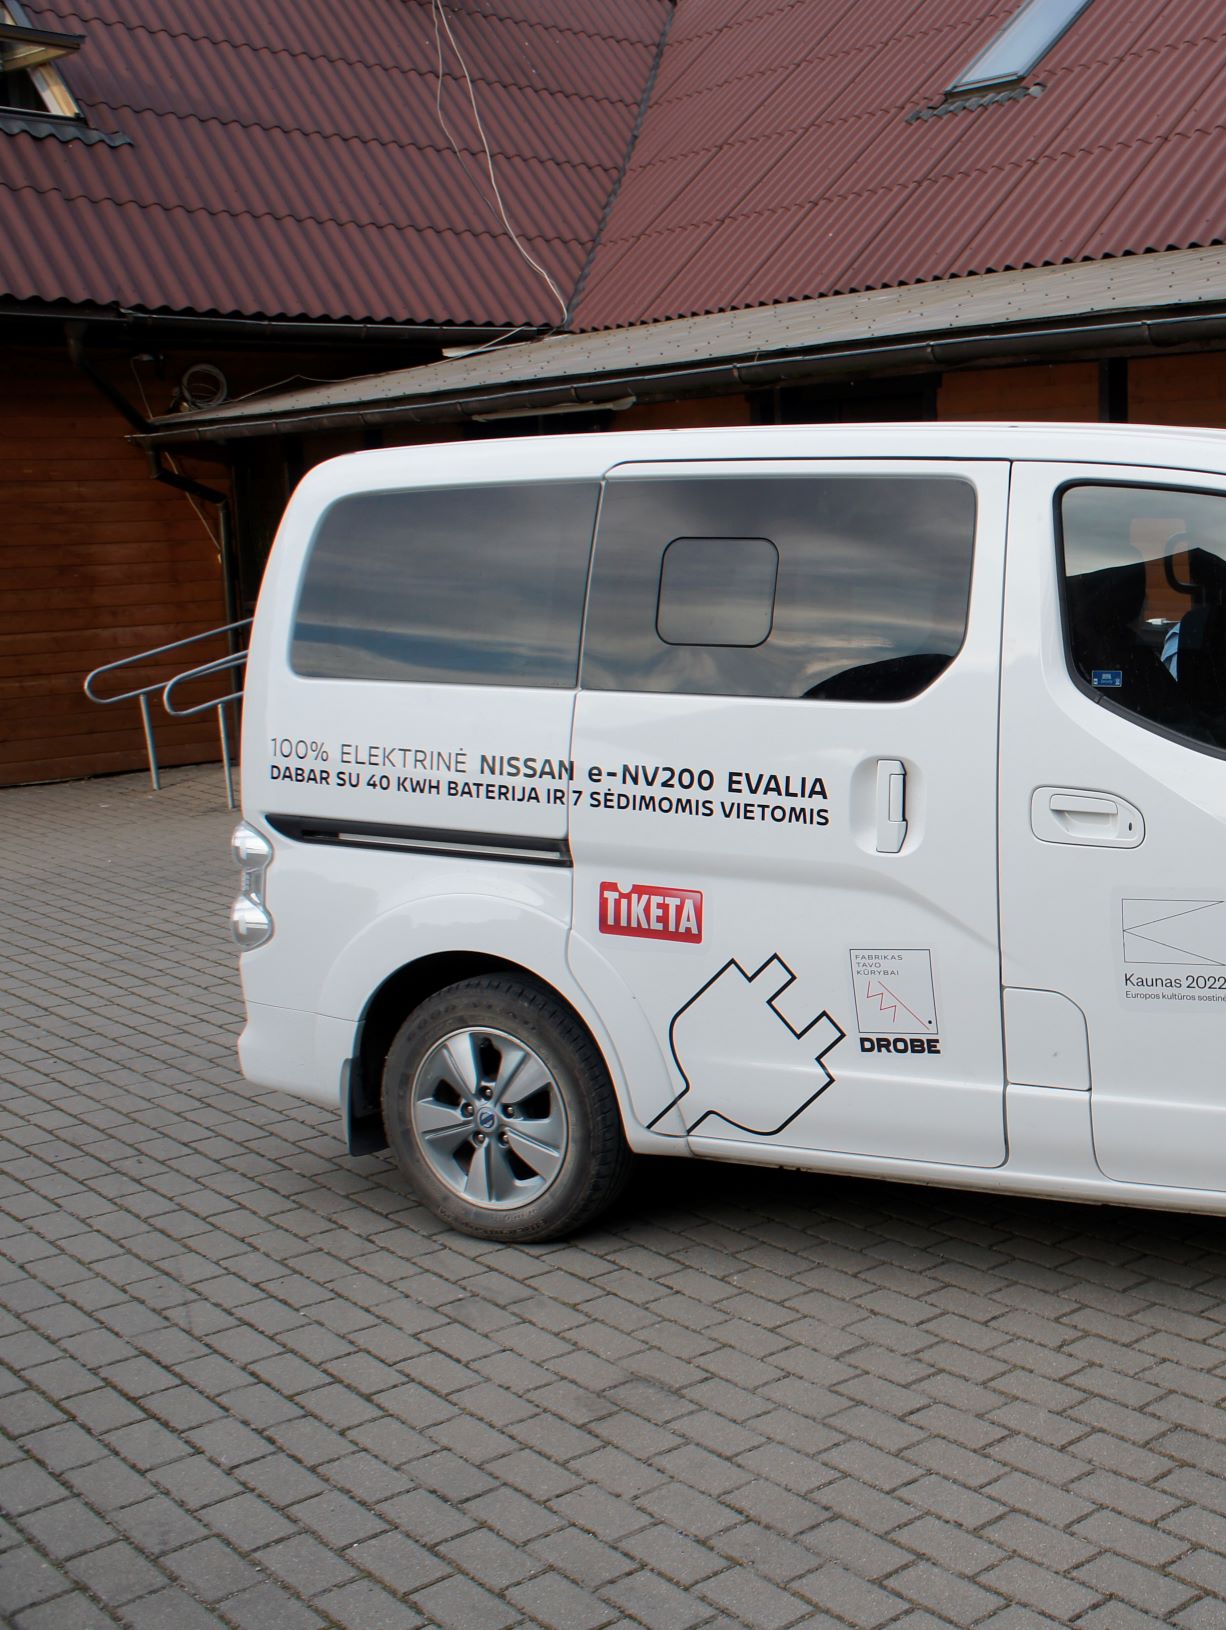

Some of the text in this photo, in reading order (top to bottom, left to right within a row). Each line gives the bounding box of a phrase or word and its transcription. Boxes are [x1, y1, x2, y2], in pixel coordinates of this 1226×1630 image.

[271, 738, 828, 799] 100% ELEKTRINĖ NISSAN e-NV200 EVALIA
[270, 765, 829, 826] DABAR SU 40 KWH BATERIJA IR 7 SĖDIMOMIS VIETOMIS
[1124, 972, 1182, 989] Kaunas
[1125, 990, 1160, 1000] Europos
[1161, 992, 1196, 1001] kultūros
[859, 1037, 941, 1054] DROBE
